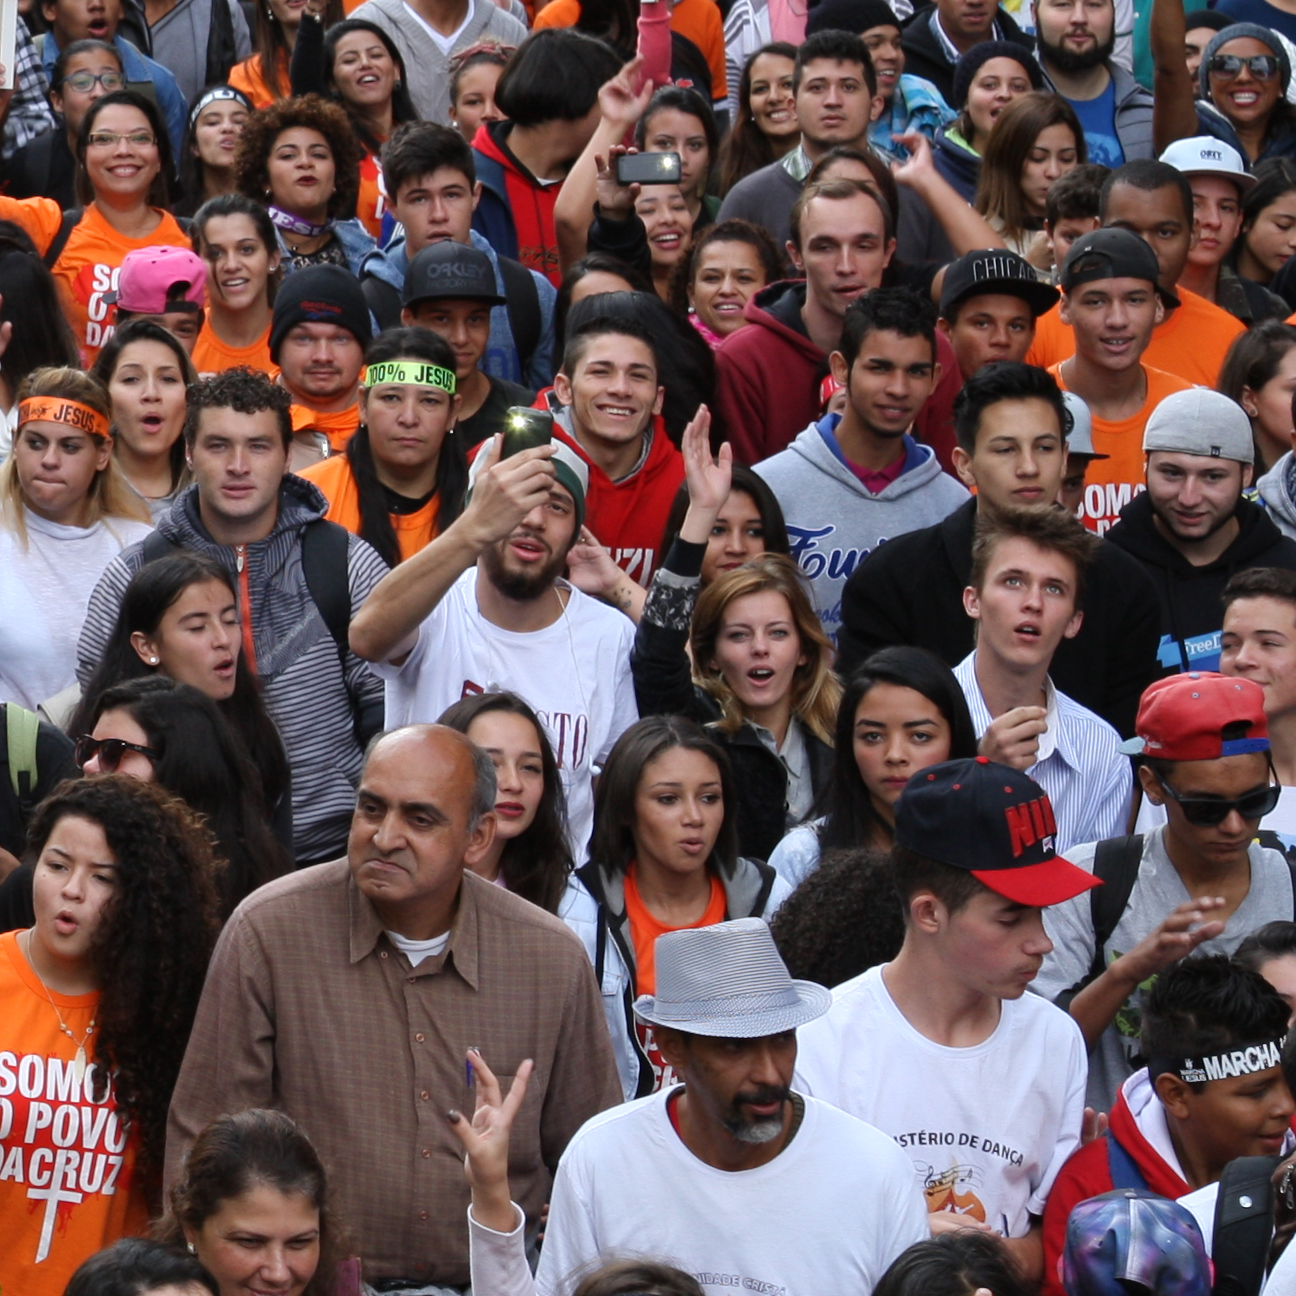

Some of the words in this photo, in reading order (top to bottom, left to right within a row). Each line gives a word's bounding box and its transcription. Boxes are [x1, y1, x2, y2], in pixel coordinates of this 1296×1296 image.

[369, 363, 406, 385] 100%
[412, 364, 454, 392] JESUS
[52, 403, 97, 433] JESUS
[1202, 1041, 1281, 1081] MARCHA
[24, 1100, 128, 1156] POVO
[958, 1132, 981, 1149] DE
[982, 1137, 1025, 1169] DANÇA
